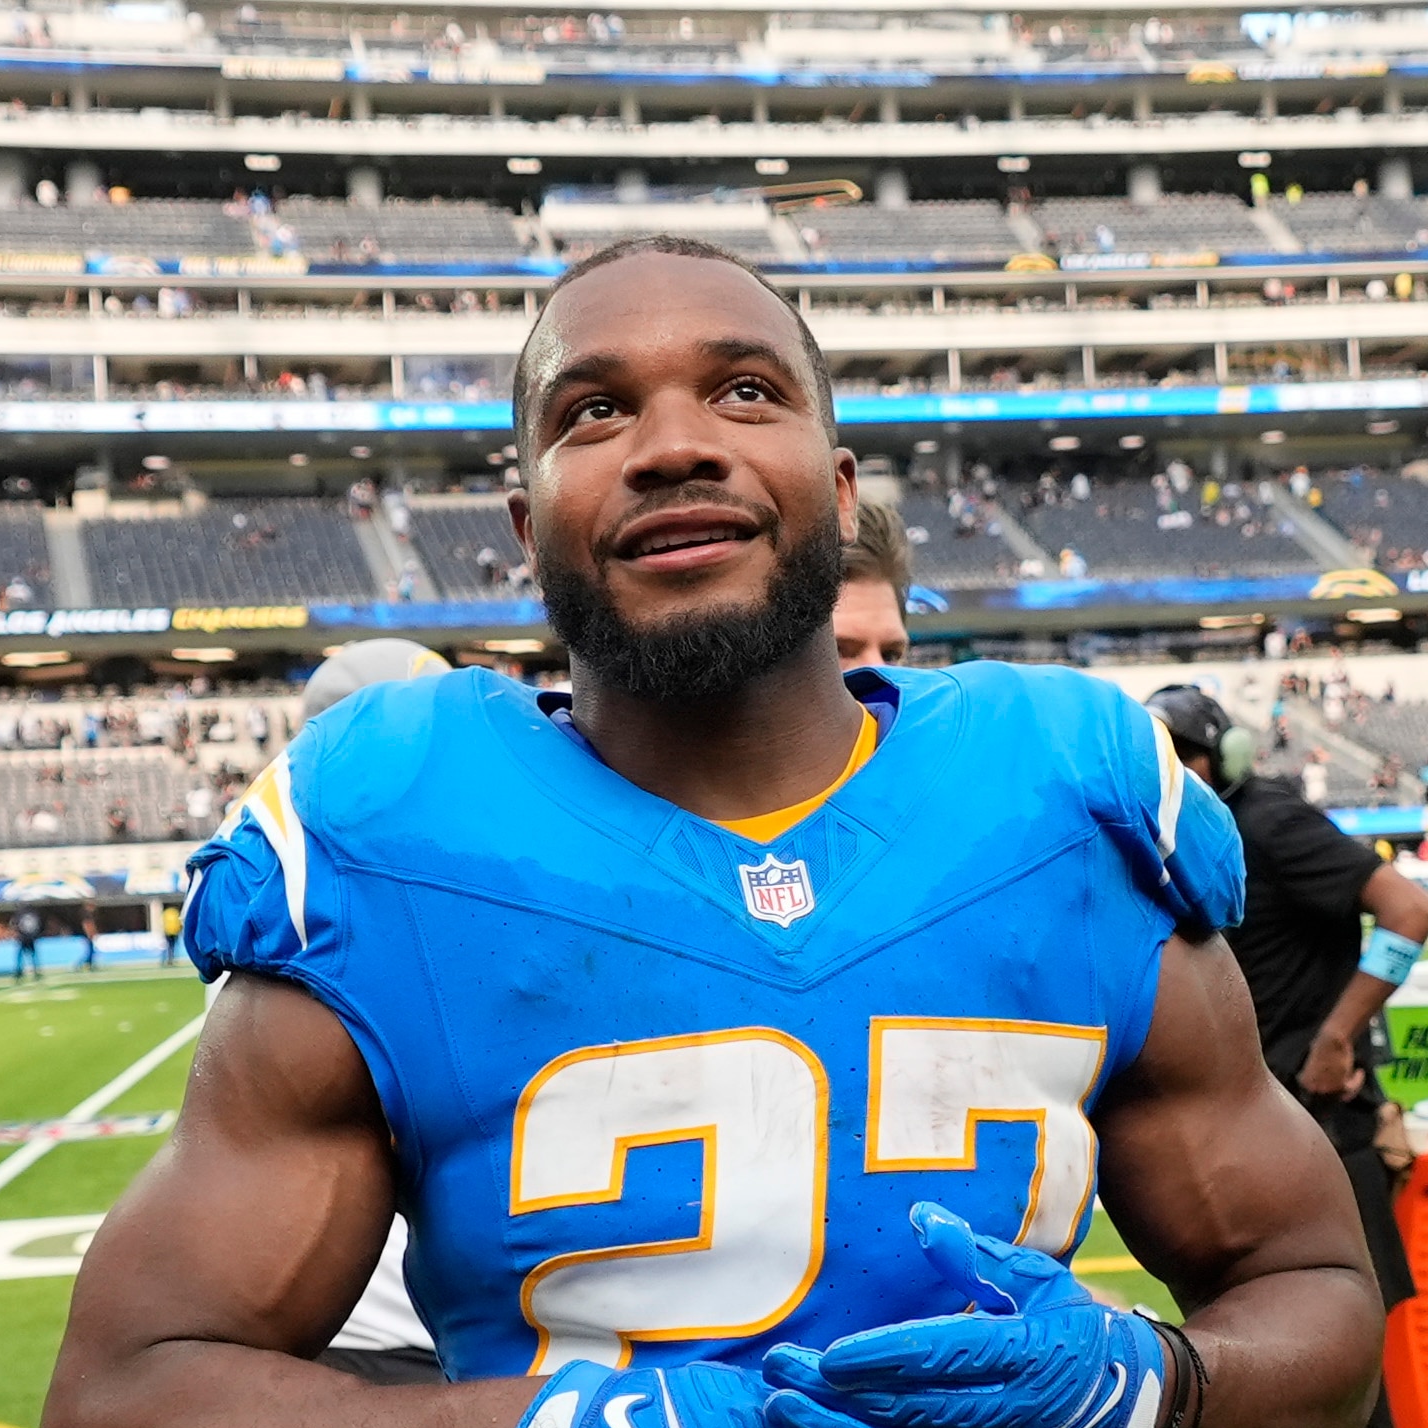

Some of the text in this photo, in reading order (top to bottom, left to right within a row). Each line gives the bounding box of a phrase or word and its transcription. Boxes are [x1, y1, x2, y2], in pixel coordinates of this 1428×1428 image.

[46, 607, 172, 638] ANGELES
[172, 606, 309, 634] CHARGERS
[756, 886, 804, 913] NFL
[509, 1016, 1108, 1378] 27
